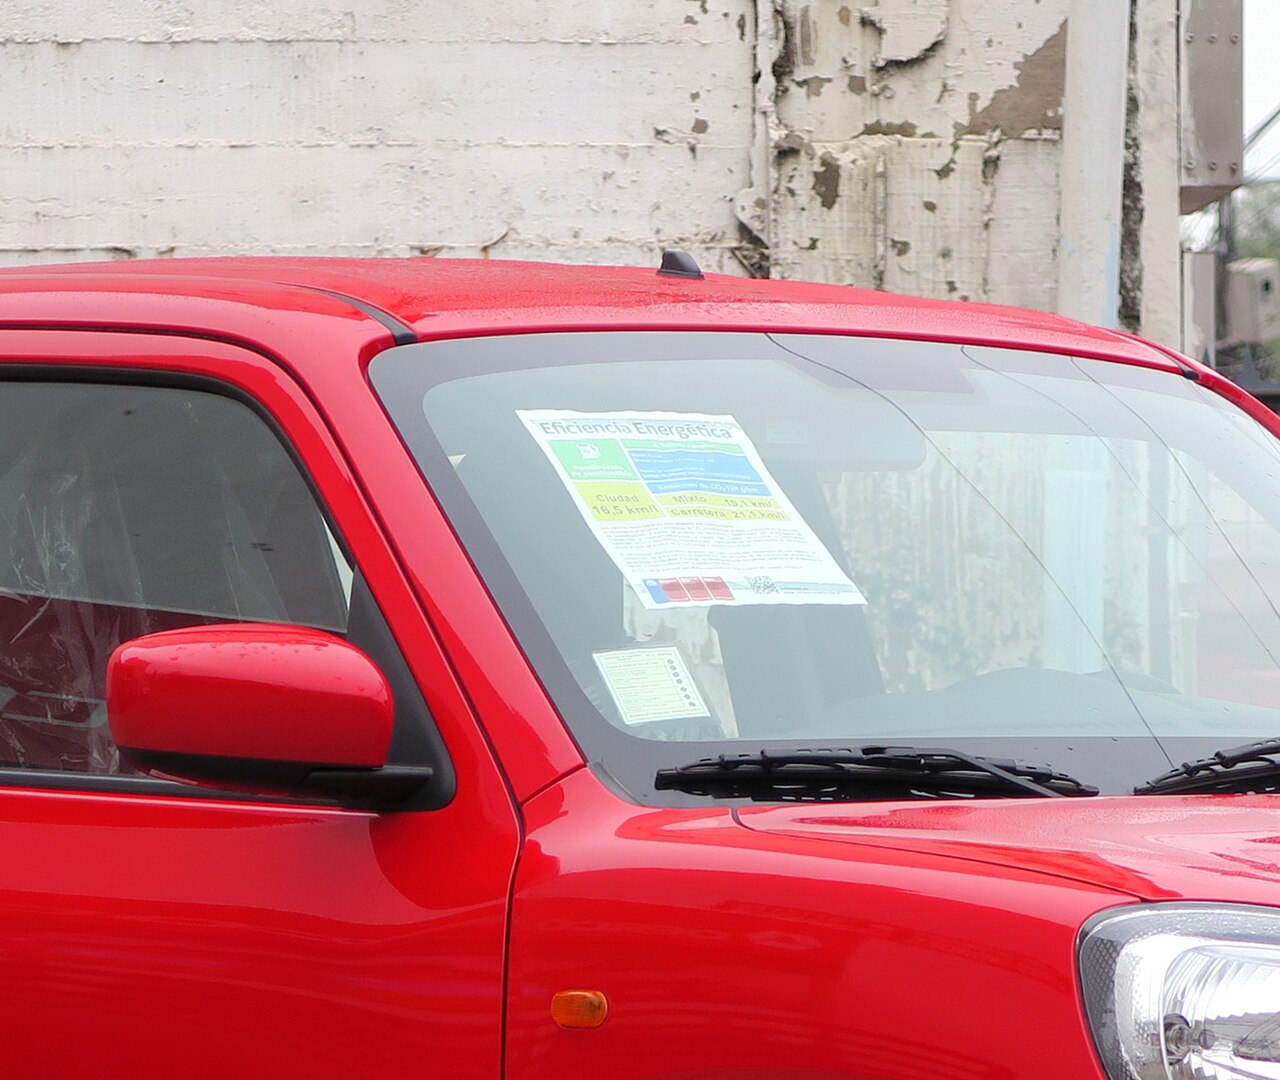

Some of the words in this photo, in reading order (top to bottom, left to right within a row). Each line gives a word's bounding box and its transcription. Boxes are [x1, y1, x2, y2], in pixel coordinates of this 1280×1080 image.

[539, 422, 632, 435] Eficiencia
[634, 422, 732, 439] Energética
[595, 494, 639, 503] Ciudad
[673, 494, 707, 504] Mixto
[627, 504, 659, 515] km/l
[671, 508, 727, 519] Carretera
